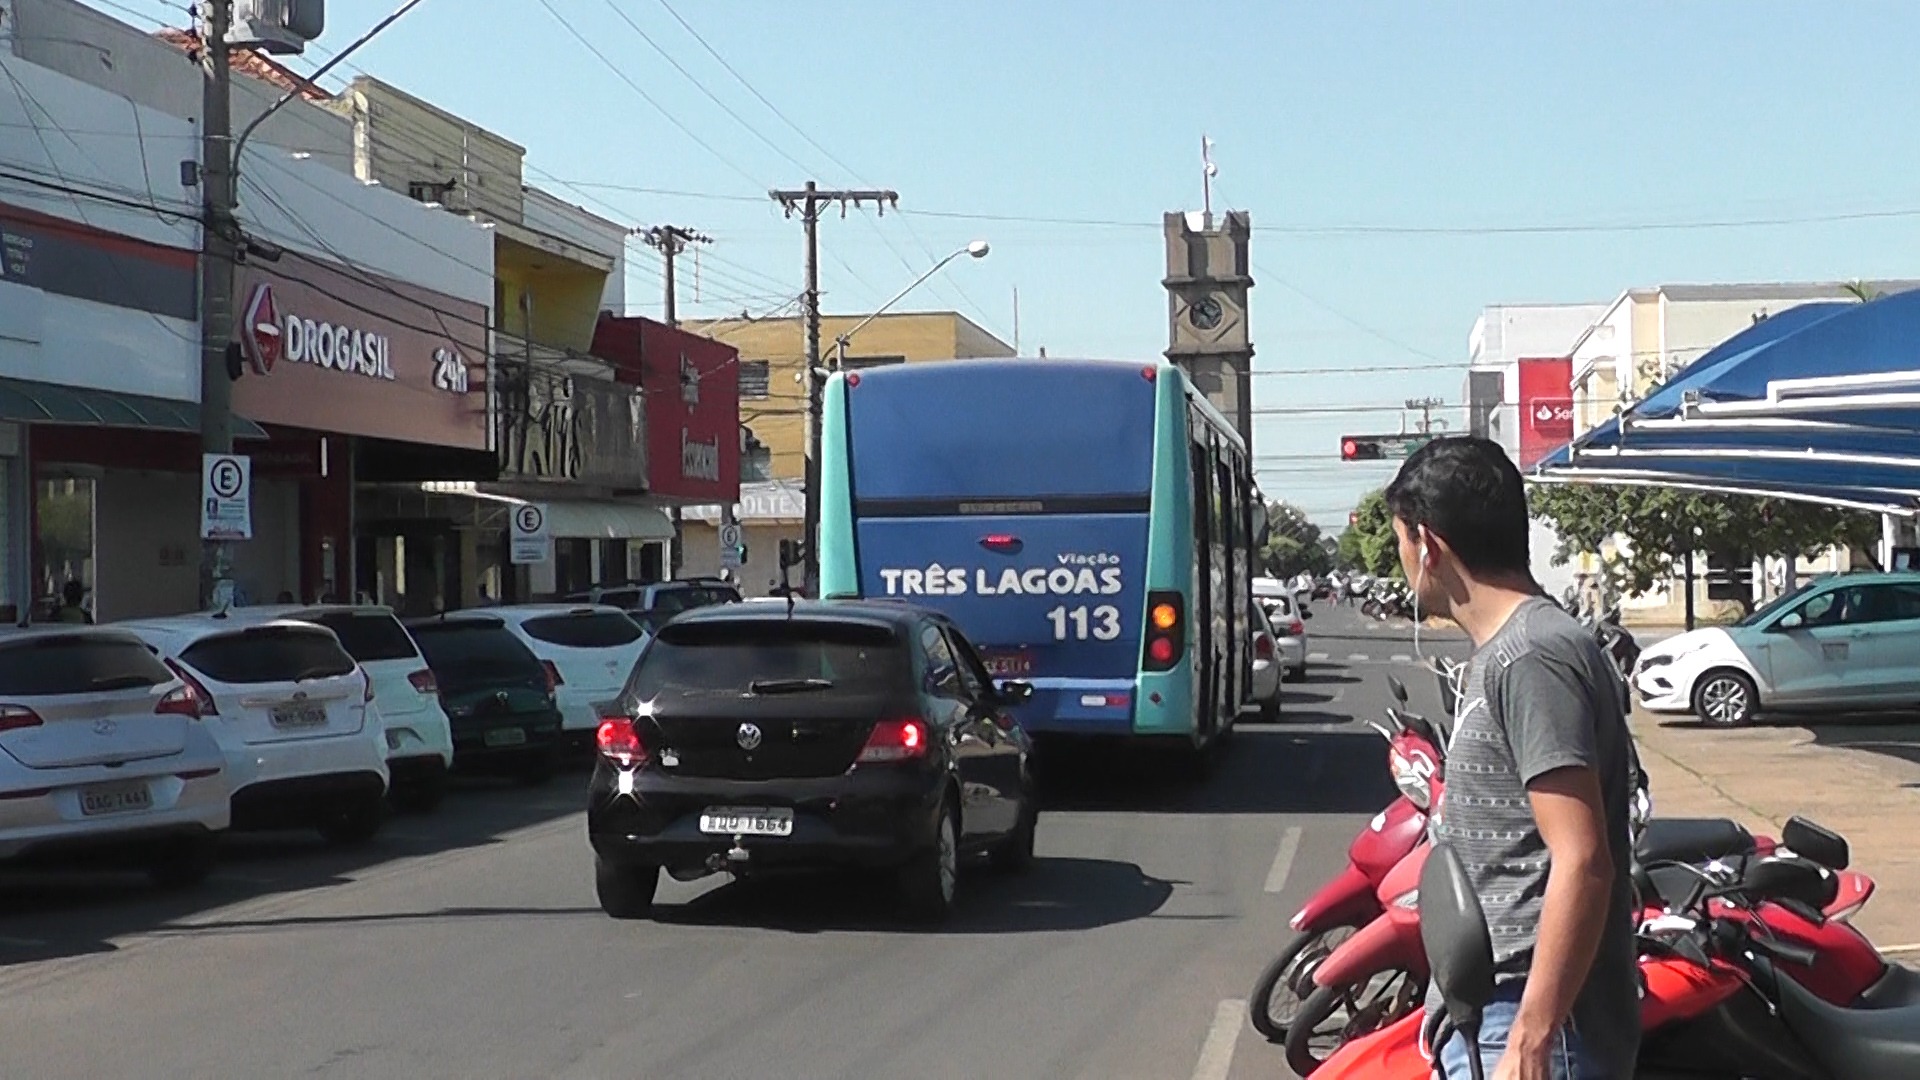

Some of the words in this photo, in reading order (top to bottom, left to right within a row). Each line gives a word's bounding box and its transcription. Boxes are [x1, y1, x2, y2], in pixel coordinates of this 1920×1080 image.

[286, 314, 395, 380] DROGASIL
[433, 347, 468, 393] 24h
[220, 467, 233, 490] E
[524, 511, 535, 528] E
[880, 562, 967, 595] TRÊS
[976, 567, 1122, 595] LAGOAS
[1046, 604, 1121, 641] 113
